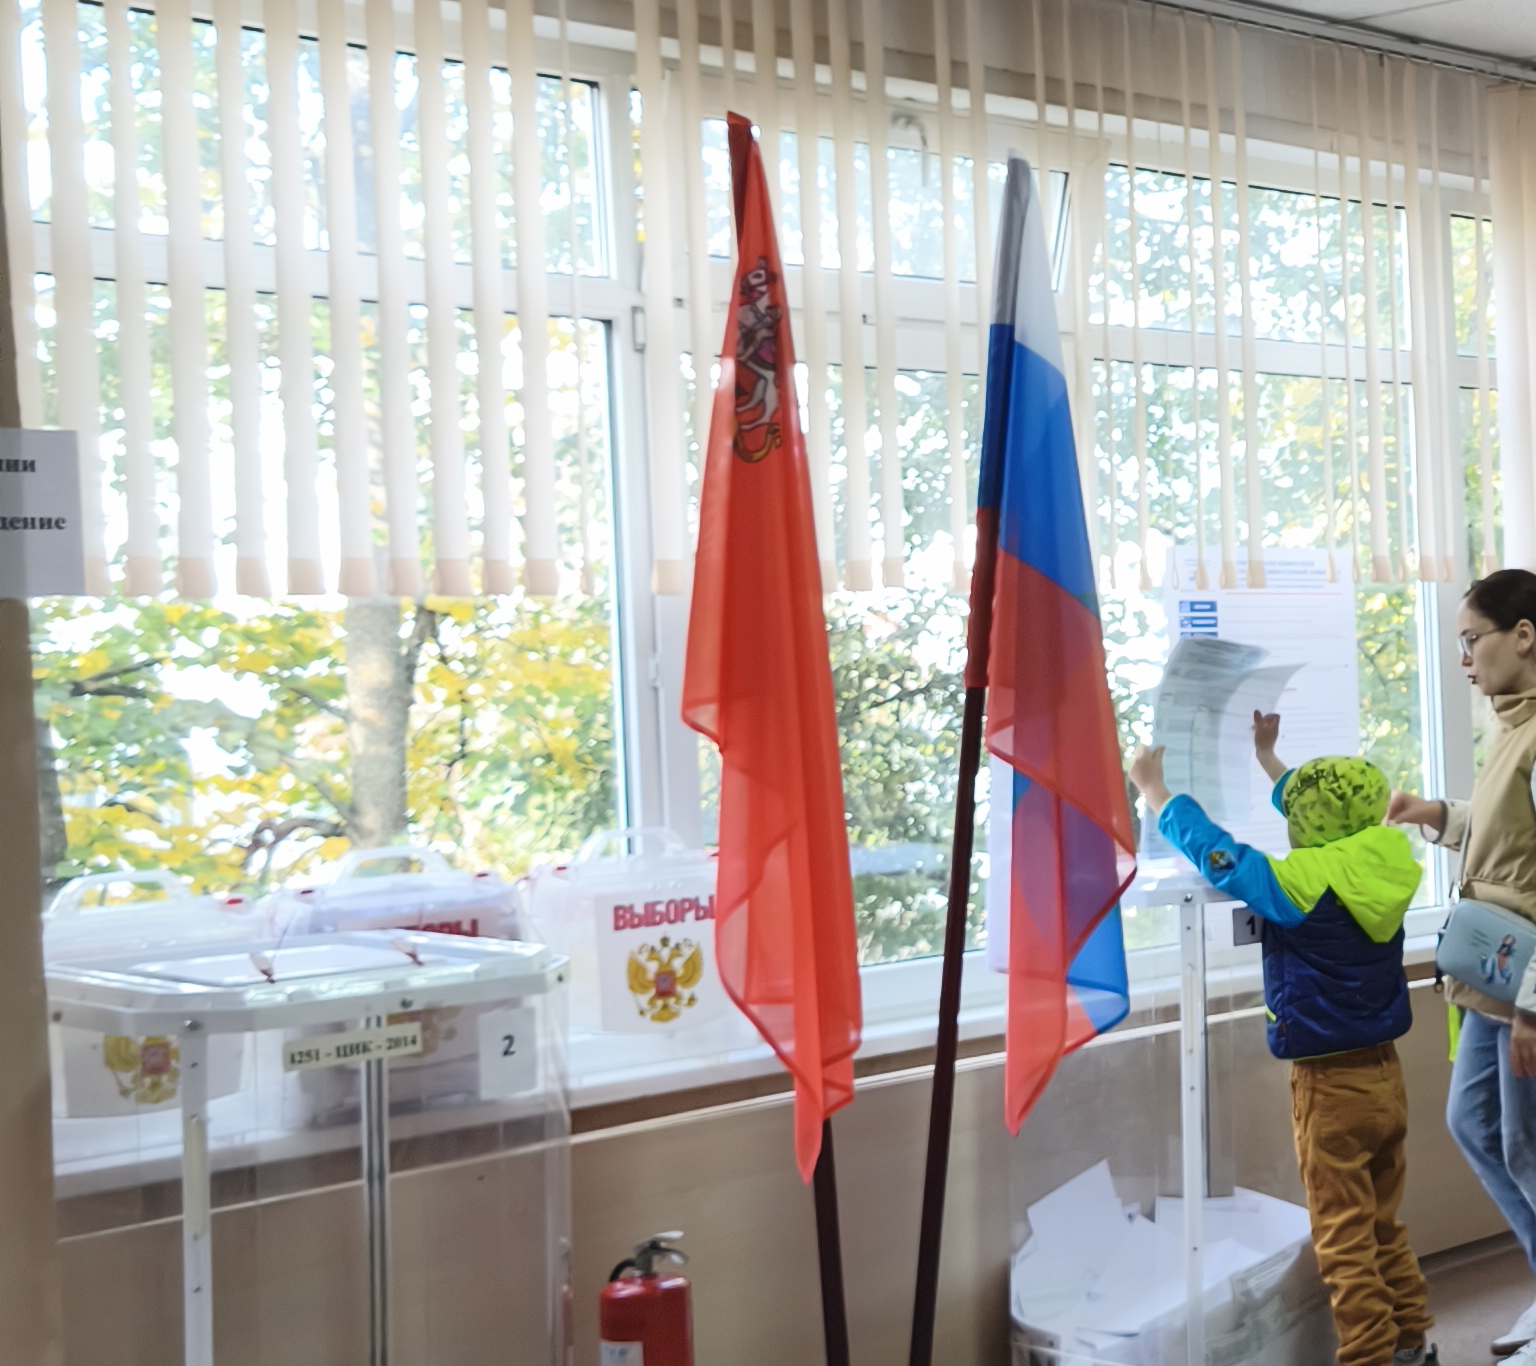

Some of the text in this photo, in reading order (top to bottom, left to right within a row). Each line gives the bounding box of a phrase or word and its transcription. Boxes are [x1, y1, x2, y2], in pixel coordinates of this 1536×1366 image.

[0, 458, 36, 473] ии
[613, 894, 715, 931] ВЫБОРЫ
[1246, 915, 1256, 936] 1
[502, 1035, 516, 1057] 2
